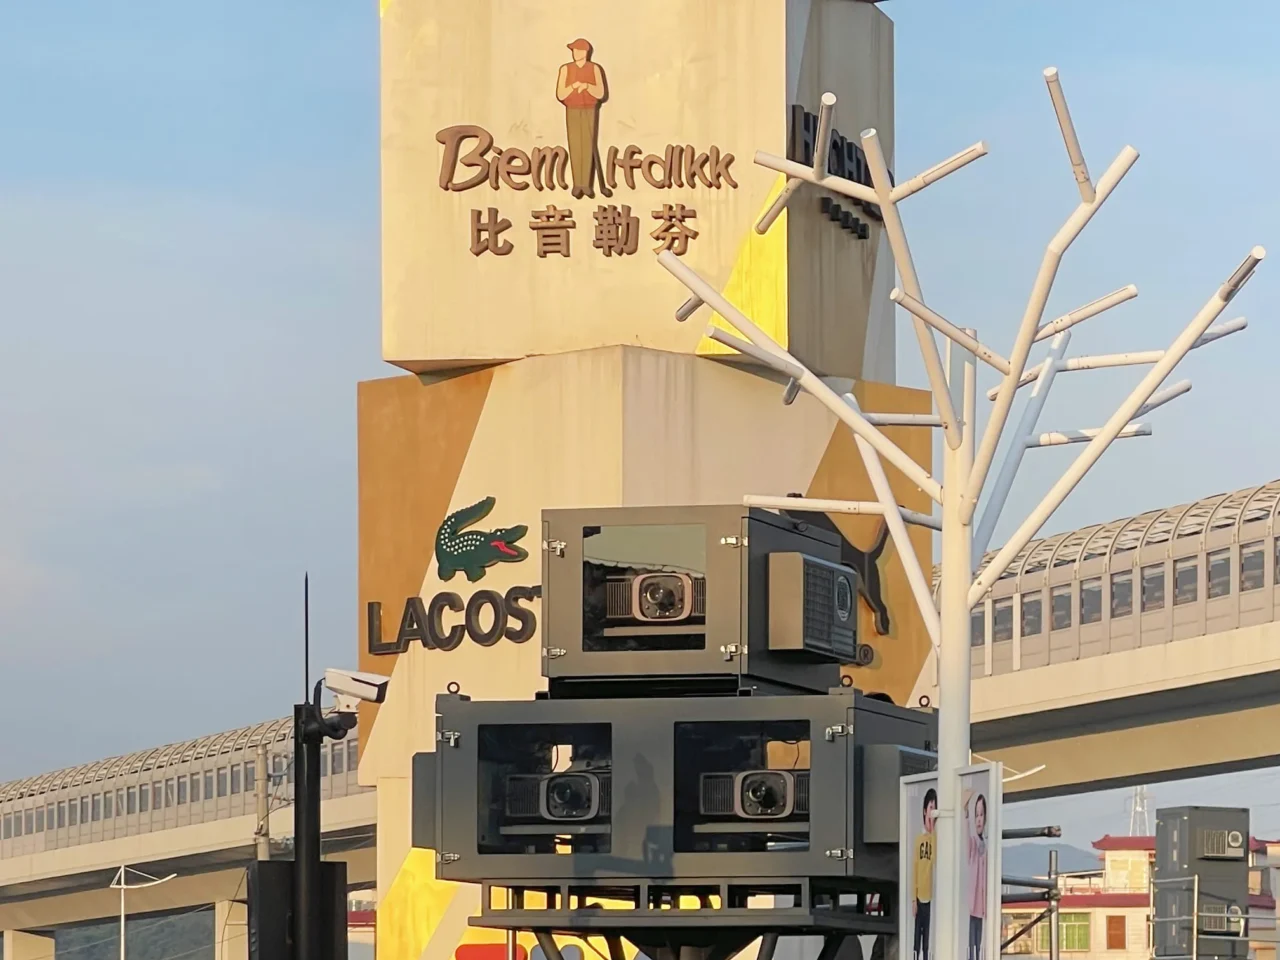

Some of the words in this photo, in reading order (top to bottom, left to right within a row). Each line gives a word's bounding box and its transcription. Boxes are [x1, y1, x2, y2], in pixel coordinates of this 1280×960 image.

[469, 203, 700, 258] 比音勒芬
[367, 584, 543, 656] LACOS
